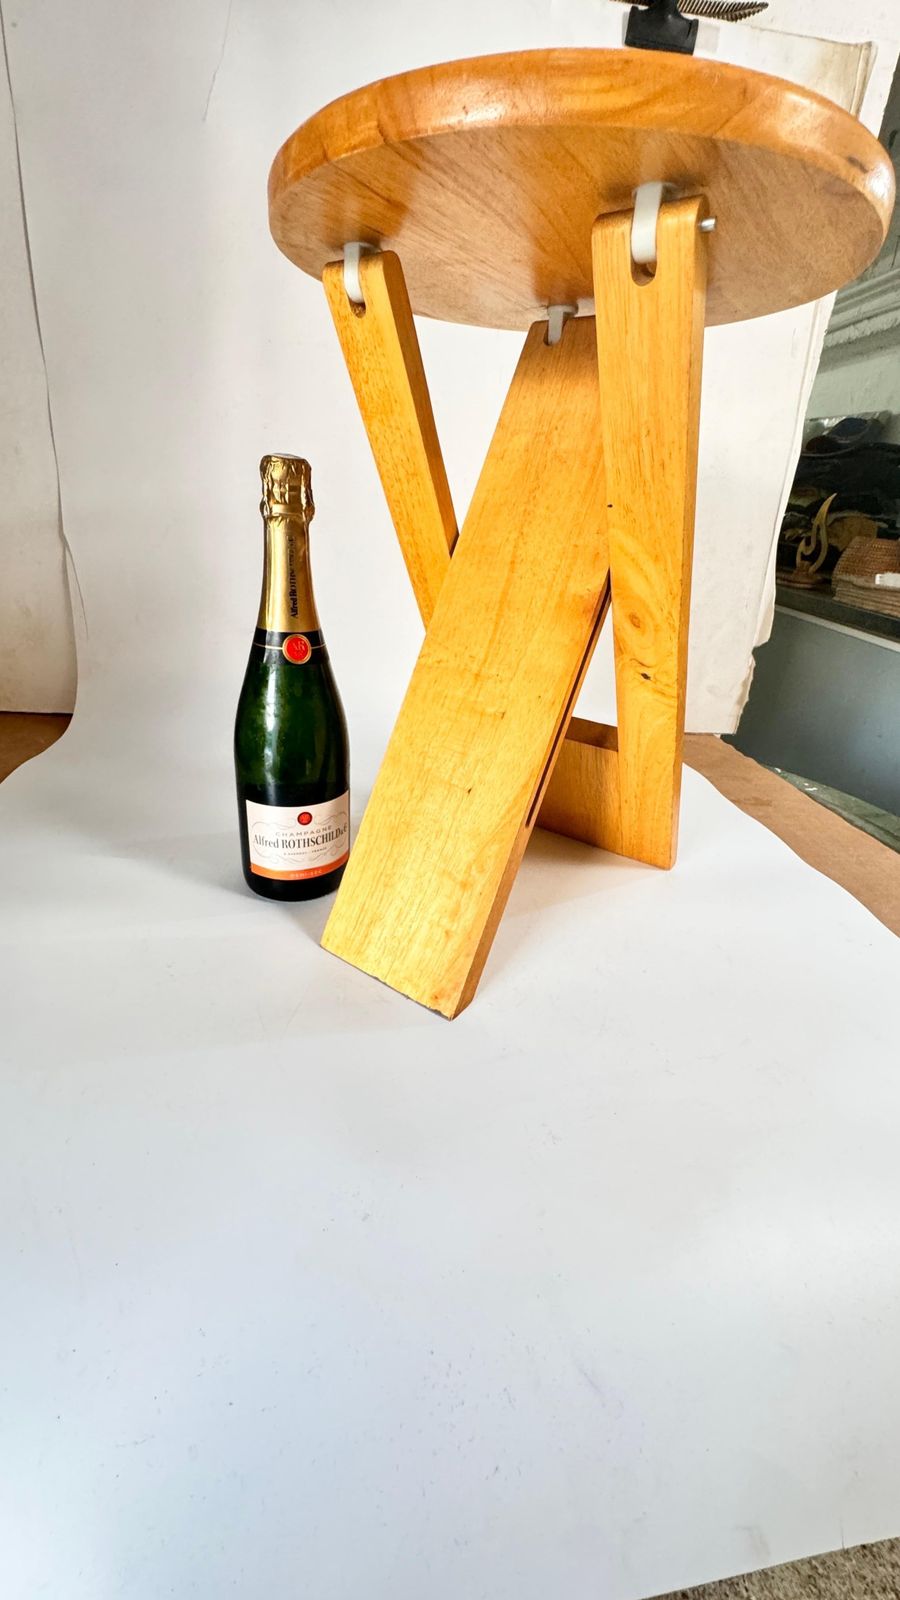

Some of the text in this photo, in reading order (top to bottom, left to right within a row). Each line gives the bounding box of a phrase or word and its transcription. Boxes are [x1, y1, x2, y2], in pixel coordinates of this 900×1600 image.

[289, 597, 299, 619] Alfred
[275, 825, 332, 837] CHAMPAGNE
[254, 834, 279, 849] Alfred
